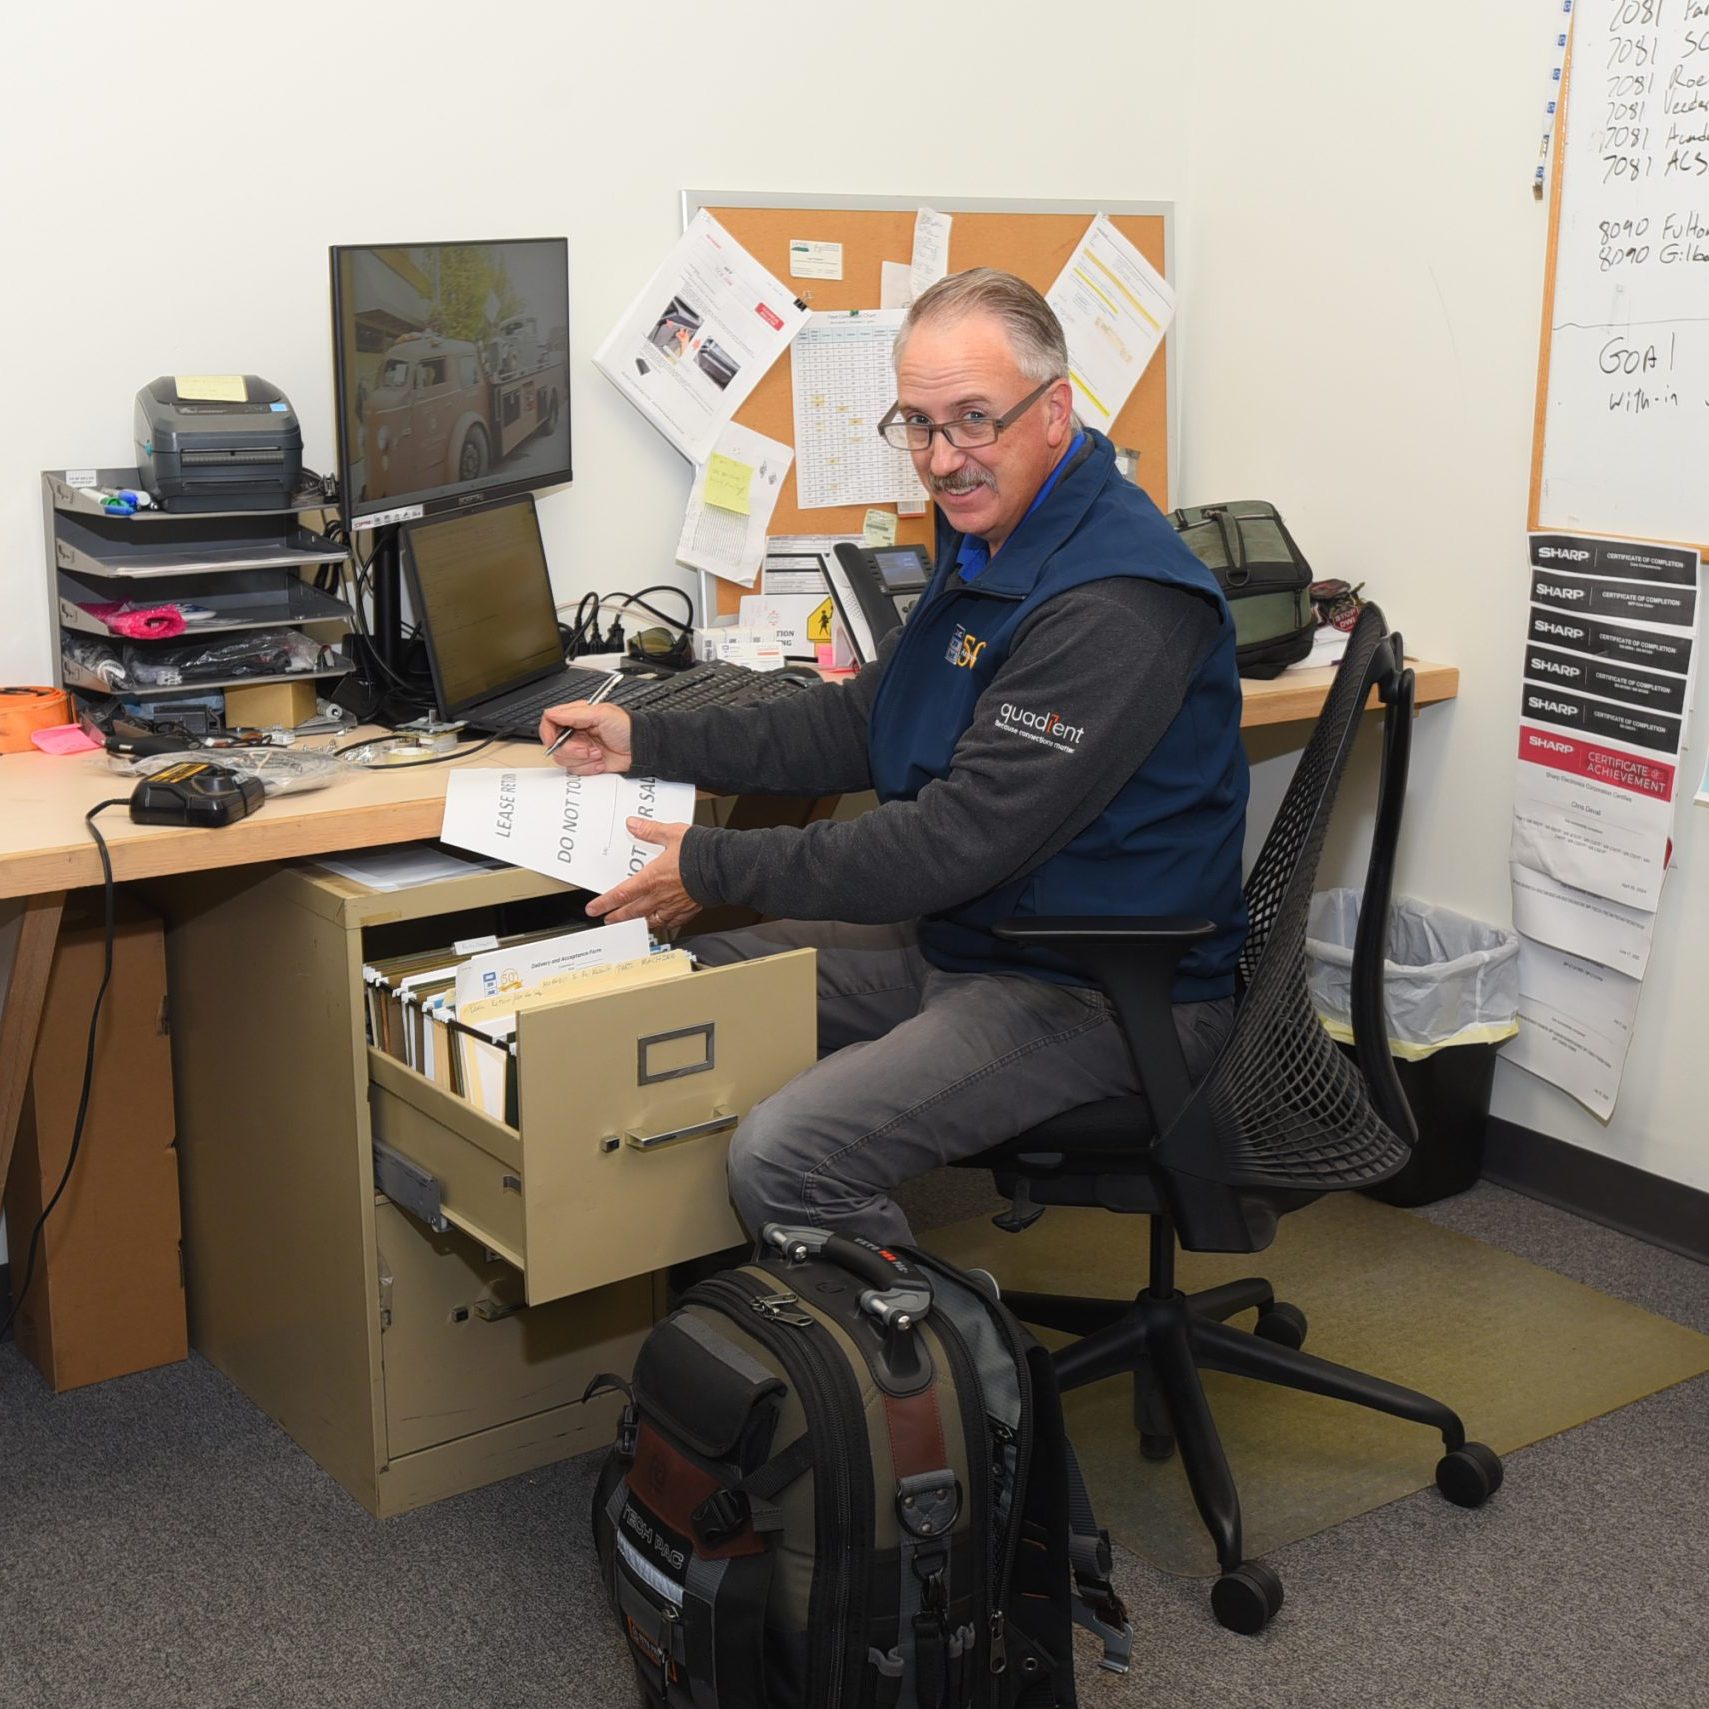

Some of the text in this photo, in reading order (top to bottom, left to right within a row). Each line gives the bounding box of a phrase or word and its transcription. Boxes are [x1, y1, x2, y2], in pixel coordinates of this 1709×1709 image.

[1606, 35, 1657, 70] 7081
[1606, 72, 1654, 98] 7081
[1606, 101, 1646, 125] 7081
[1604, 126, 1649, 150] 7081
[1603, 154, 1652, 184] 7081
[1598, 217, 1650, 245] 8090
[1538, 547, 1590, 561] SHARP
[1606, 552, 1641, 562] CERTIFICATE
[1650, 558, 1684, 568] COMPLETION
[1536, 583, 1585, 599] SHARP
[1602, 591, 1637, 601] CERTIFICATE
[1645, 597, 1681, 606] COMPLETION
[1534, 620, 1584, 639] SHARP
[1599, 633, 1632, 645] CERTIFICATE
[1641, 642, 1676, 653] COMPLETION
[1530, 658, 1581, 677] SHARP
[1595, 672, 1627, 684] CERTIFICATE
[1636, 681, 1671, 693] COMPLETION
[1528, 696, 1578, 716] SHARP
[1000, 703, 1085, 743] quadient
[1593, 711, 1624, 723] CERTIFICATE
[1632, 720, 1666, 733] COMPLETION
[994, 719, 1076, 754] Because connections matter
[1529, 735, 1574, 754] SHARP
[1587, 752, 1649, 776] CERTIFICATE
[639, 776, 656, 803] SAL
[1587, 763, 1666, 793] ACHIEVEMENT
[495, 795, 516, 838] LEASE
[562, 798, 580, 833] NOT
[557, 836, 575, 864] DO
[531, 959, 551, 969] Delivery
[561, 951, 589, 962] Acceptance
[589, 947, 602, 955] Form
[622, 1502, 685, 1570] TECH PAC
